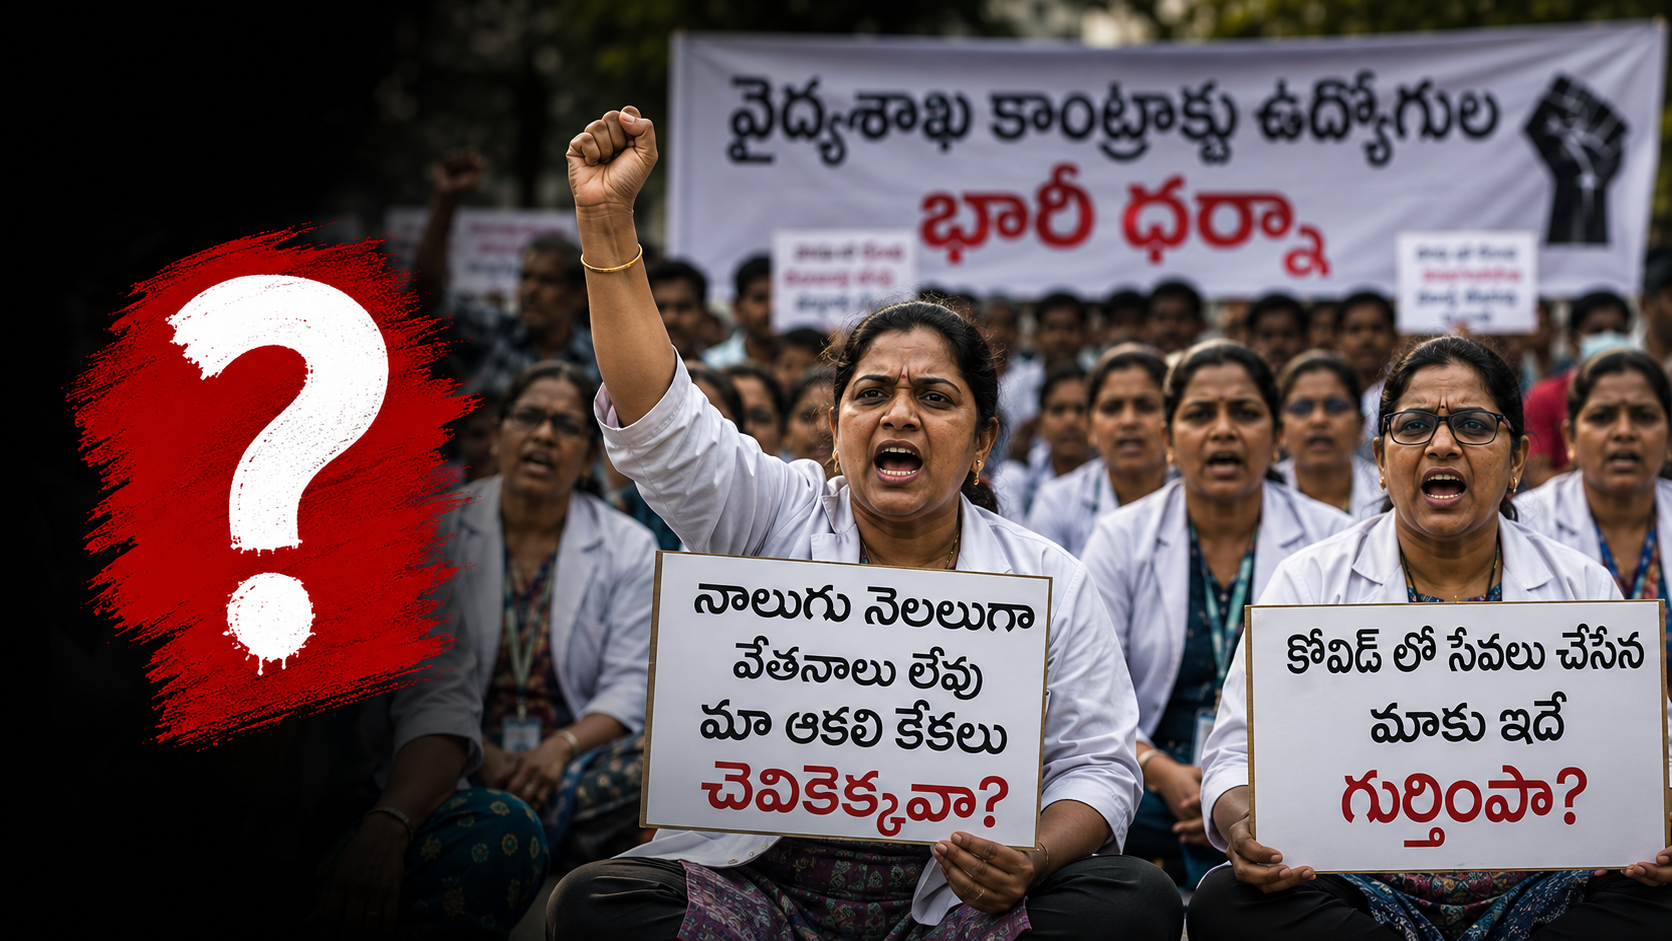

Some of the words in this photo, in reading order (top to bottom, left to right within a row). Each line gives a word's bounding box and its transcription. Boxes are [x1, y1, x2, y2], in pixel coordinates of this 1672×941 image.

[726, 73, 973, 167] వైద్యశాఖ
[989, 78, 1239, 164] కాంట్రాక్టు
[1253, 69, 1500, 167] ఉద్యోగుల
[919, 162, 1095, 264] భారీ
[1122, 174, 1331, 277] ధర్నా
[694, 583, 851, 622] నాలుగు
[865, 586, 1036, 632] నెలలుగా
[733, 636, 896, 687] వేతనాలు
[909, 647, 983, 700] లేవు
[1287, 628, 1382, 674] కోవిడ్
[1394, 625, 1436, 672] లో
[1447, 627, 1545, 671] సేవలు
[700, 699, 772, 741] మా
[786, 707, 882, 748] ఆకలి
[895, 700, 1008, 755] కేకలు
[1371, 703, 1485, 743] మాకు
[1500, 691, 1567, 745] ఇదే
[701, 760, 1010, 837] చెవికెక్కవా?
[1342, 765, 1588, 848] గుర్తింపా?
